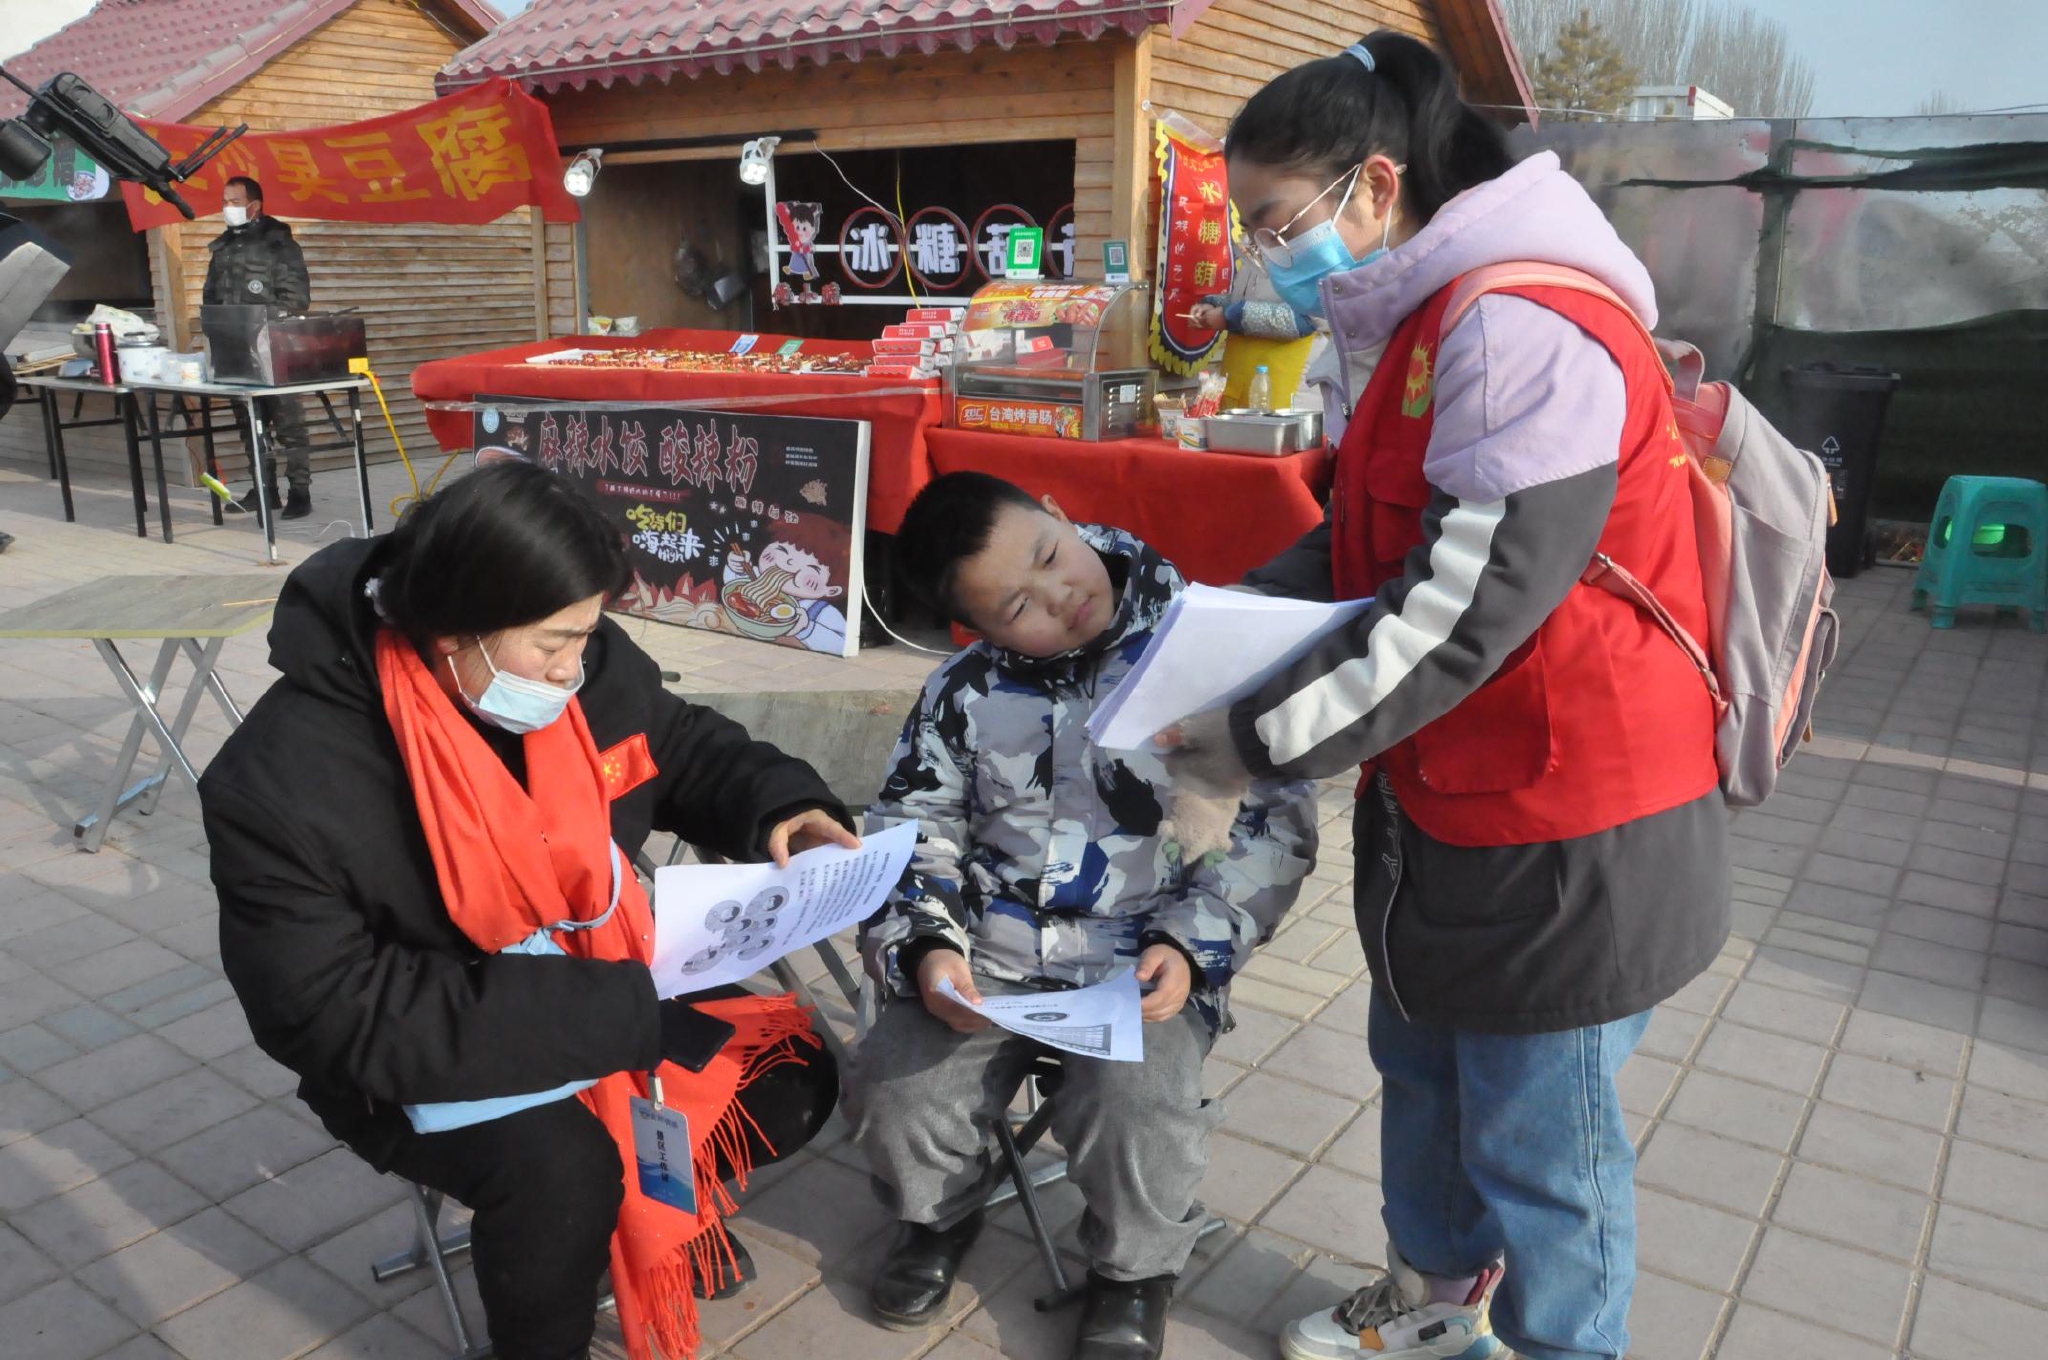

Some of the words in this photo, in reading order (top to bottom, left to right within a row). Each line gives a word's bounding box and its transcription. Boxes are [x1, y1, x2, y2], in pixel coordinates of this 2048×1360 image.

[989, 406, 1052, 425] 台湾烤香肠
[659, 418, 759, 494] 酸辣粉
[626, 504, 687, 534] 吃货们
